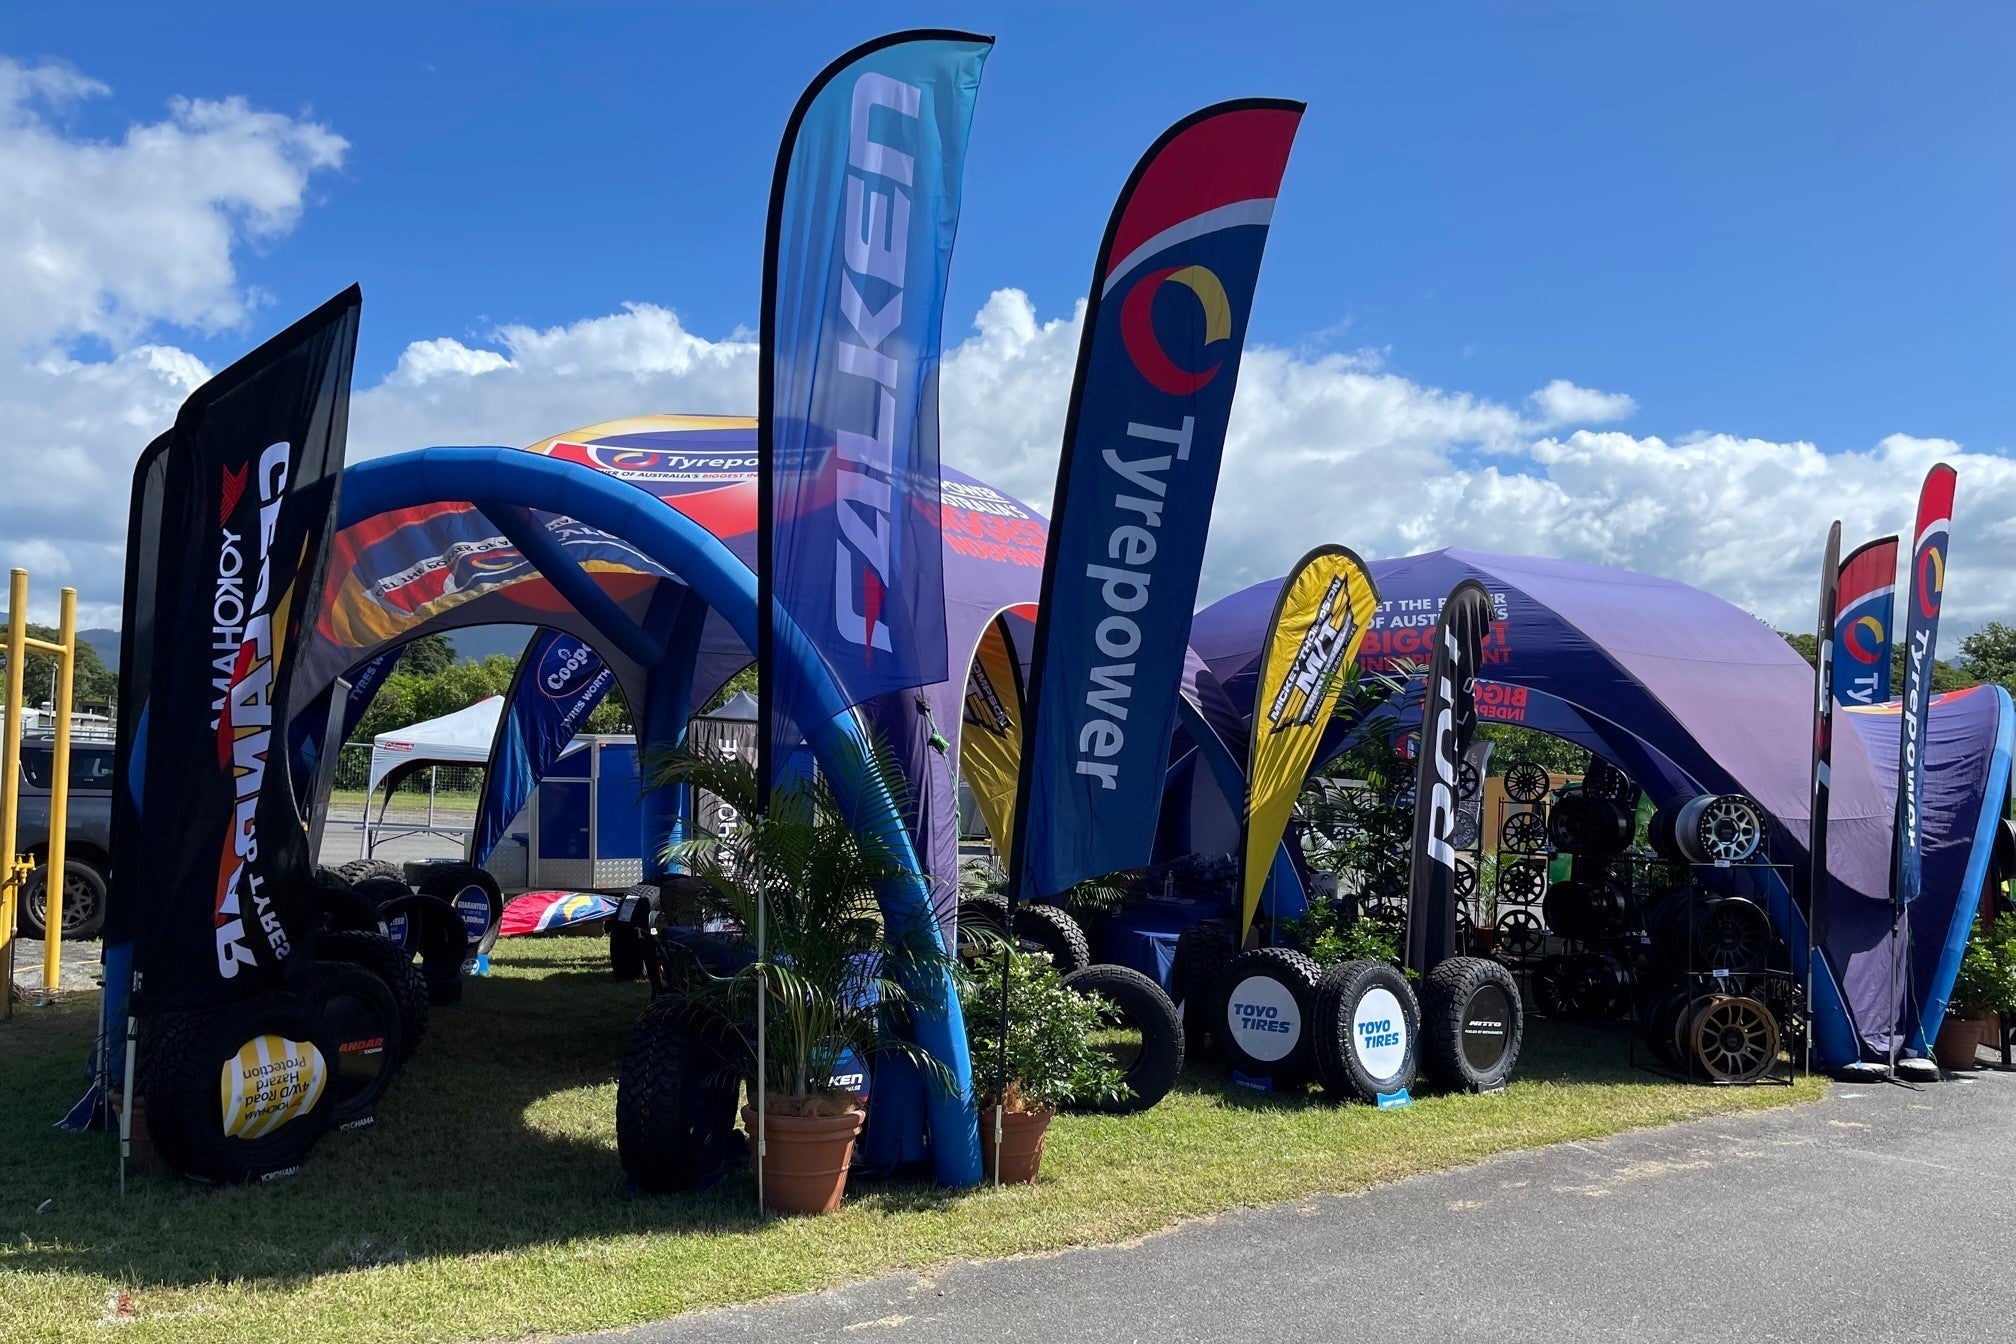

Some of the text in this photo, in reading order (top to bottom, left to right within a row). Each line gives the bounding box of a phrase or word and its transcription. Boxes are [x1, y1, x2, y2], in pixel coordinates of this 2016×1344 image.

[836, 72, 921, 656] FALKEN
[638, 471, 699, 479] AUSTRALIA'S
[1075, 415, 1196, 791] Tyrepower
[1399, 598, 1432, 611] THE
[547, 643, 592, 690] Coop
[582, 668, 611, 701] WORTH
[971, 660, 1008, 727] OMPSON
[1271, 660, 1299, 721] MICKEY
[1234, 1003, 1278, 1018] TOYO
[1241, 1017, 1291, 1034] TIRES
[1358, 1019, 1391, 1036] TOYO
[1468, 1020, 1502, 1028] NITTO
[1364, 1032, 1400, 1049] TIRES
[243, 1056, 306, 1080] Protection
[256, 1071, 300, 1093] Hazard
[245, 1081, 310, 1108] 4WD Road
[245, 1101, 289, 1121] YOKOHAMA
